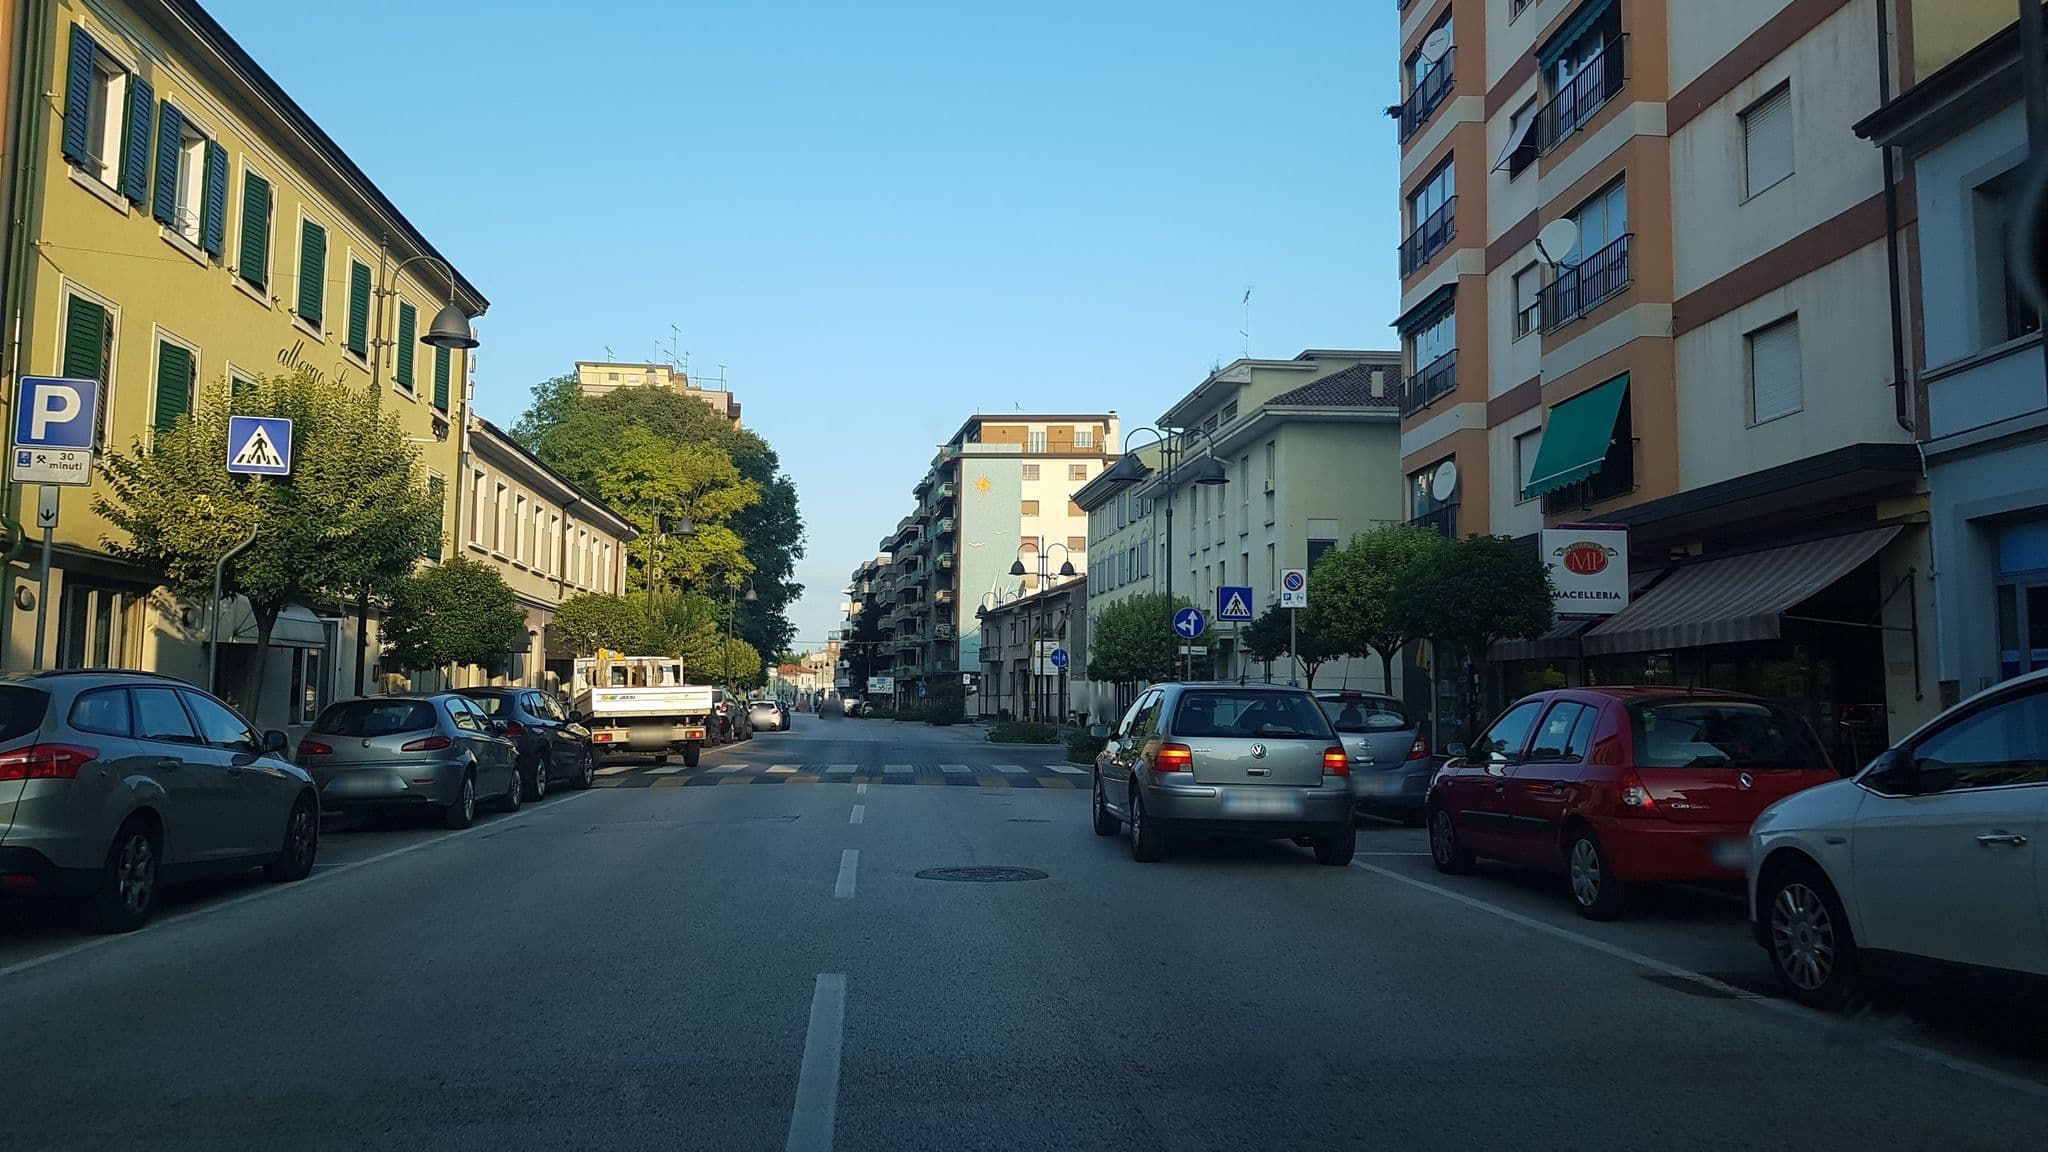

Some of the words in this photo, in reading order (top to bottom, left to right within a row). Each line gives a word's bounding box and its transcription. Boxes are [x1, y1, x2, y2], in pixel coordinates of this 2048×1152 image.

[31, 384, 81, 440] P
[59, 452, 75, 461] 30
[49, 462, 83, 471] minuti
[1552, 591, 1621, 600] MACELLERIA
